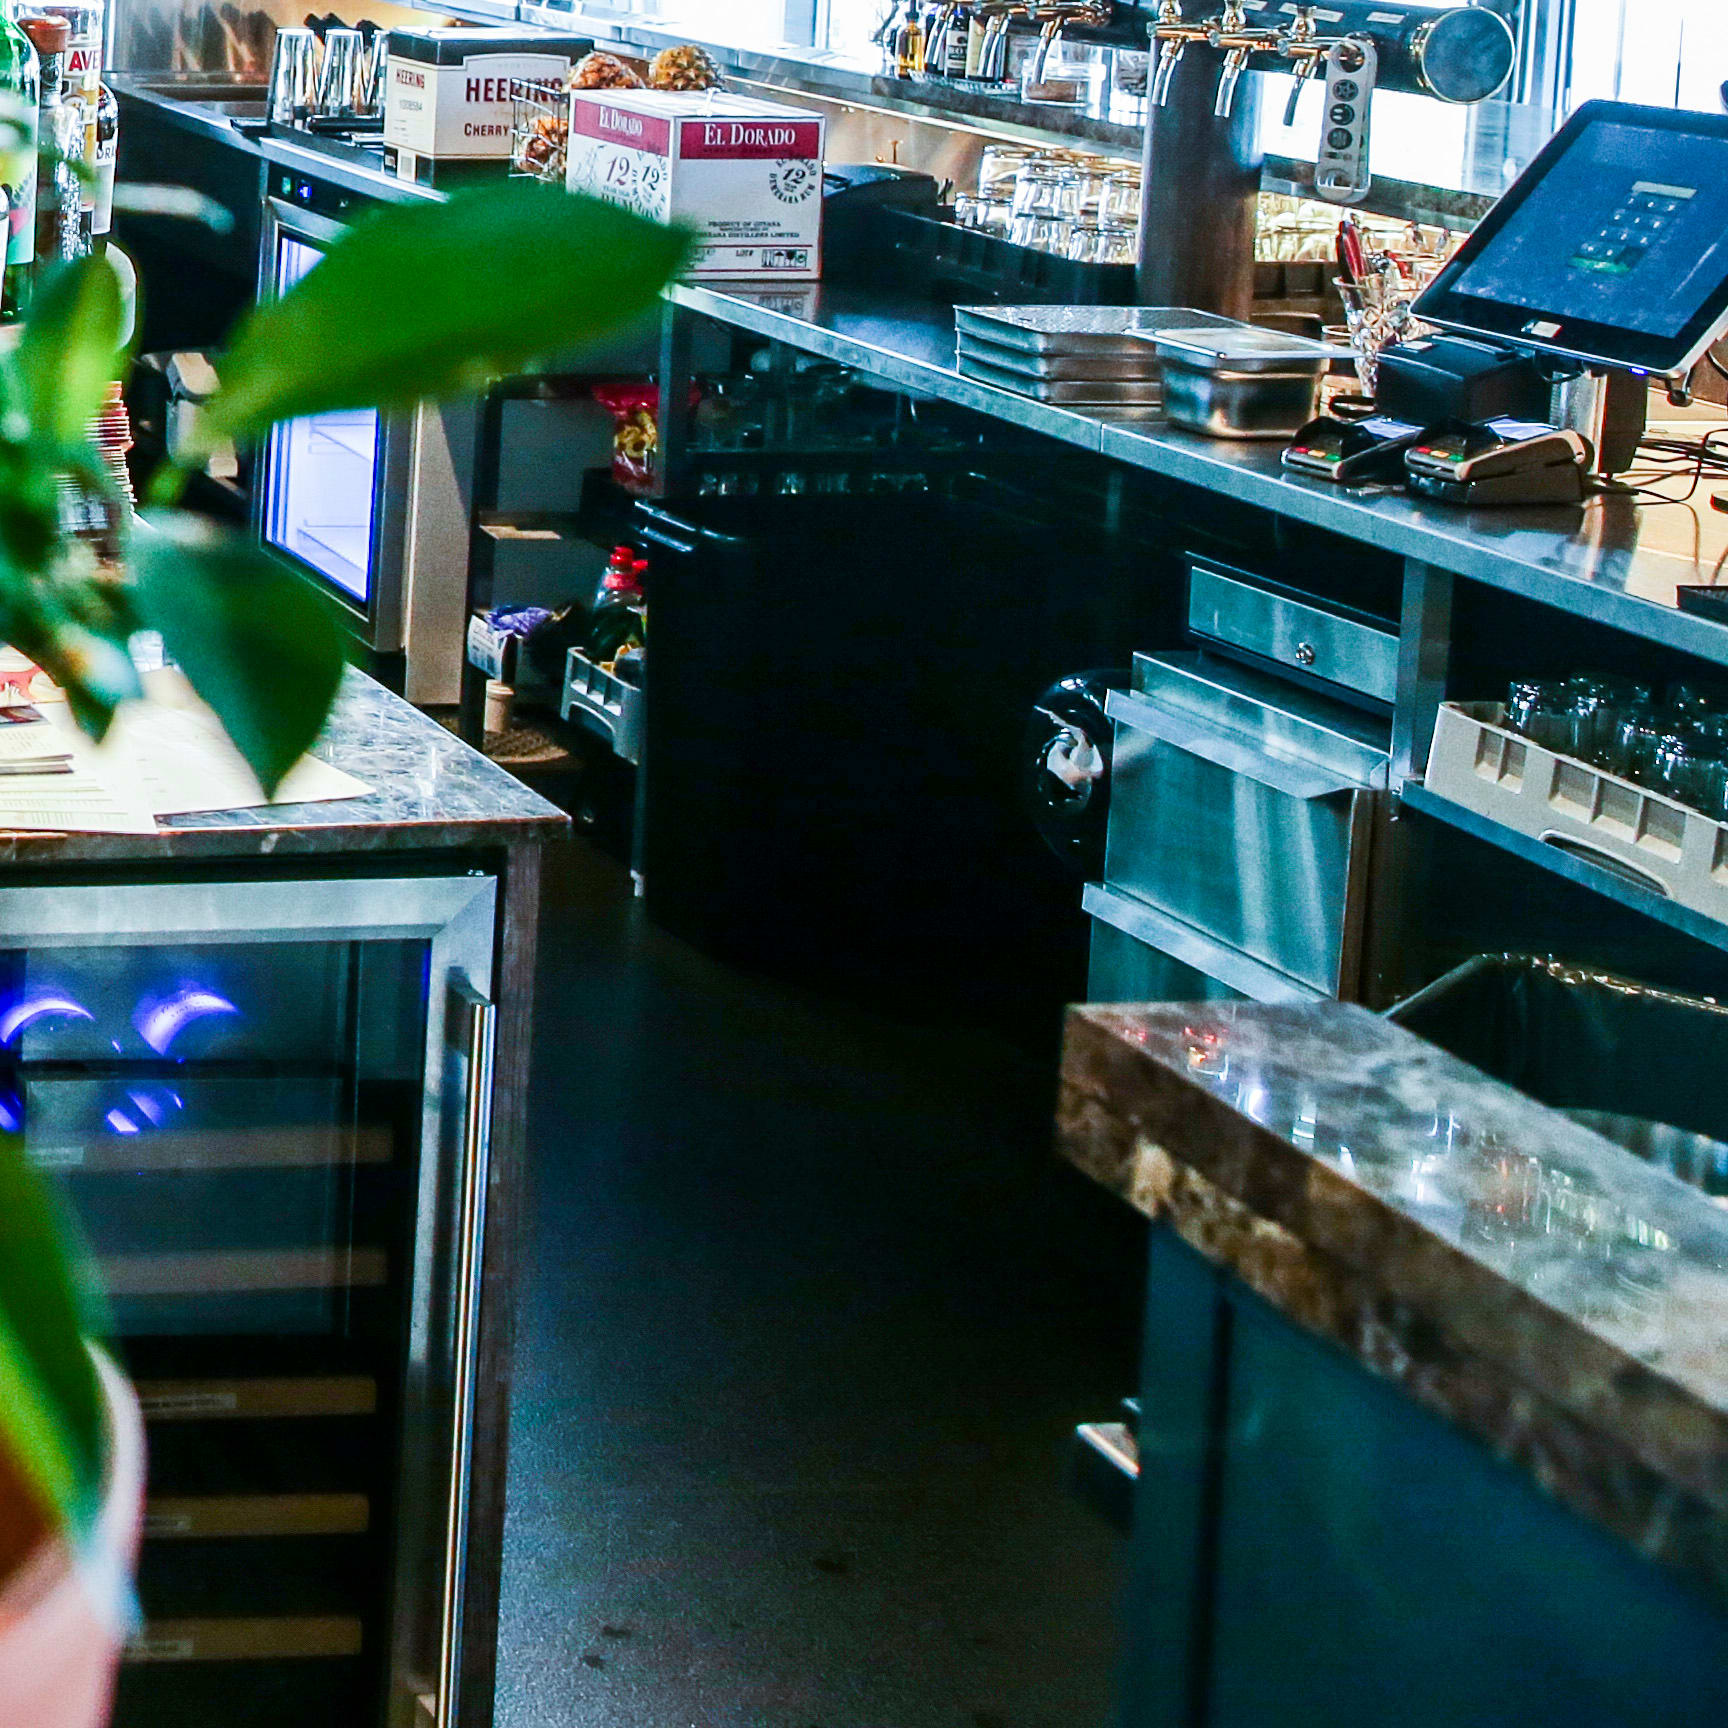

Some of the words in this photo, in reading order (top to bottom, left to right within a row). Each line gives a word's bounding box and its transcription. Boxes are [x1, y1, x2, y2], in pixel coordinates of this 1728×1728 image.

[464, 122, 510, 137] CHERRY
[611, 108, 643, 137] DORADO
[704, 123, 726, 146] EL
[730, 123, 796, 147] DORADO
[606, 156, 631, 186] 12
[783, 168, 806, 184] 12
